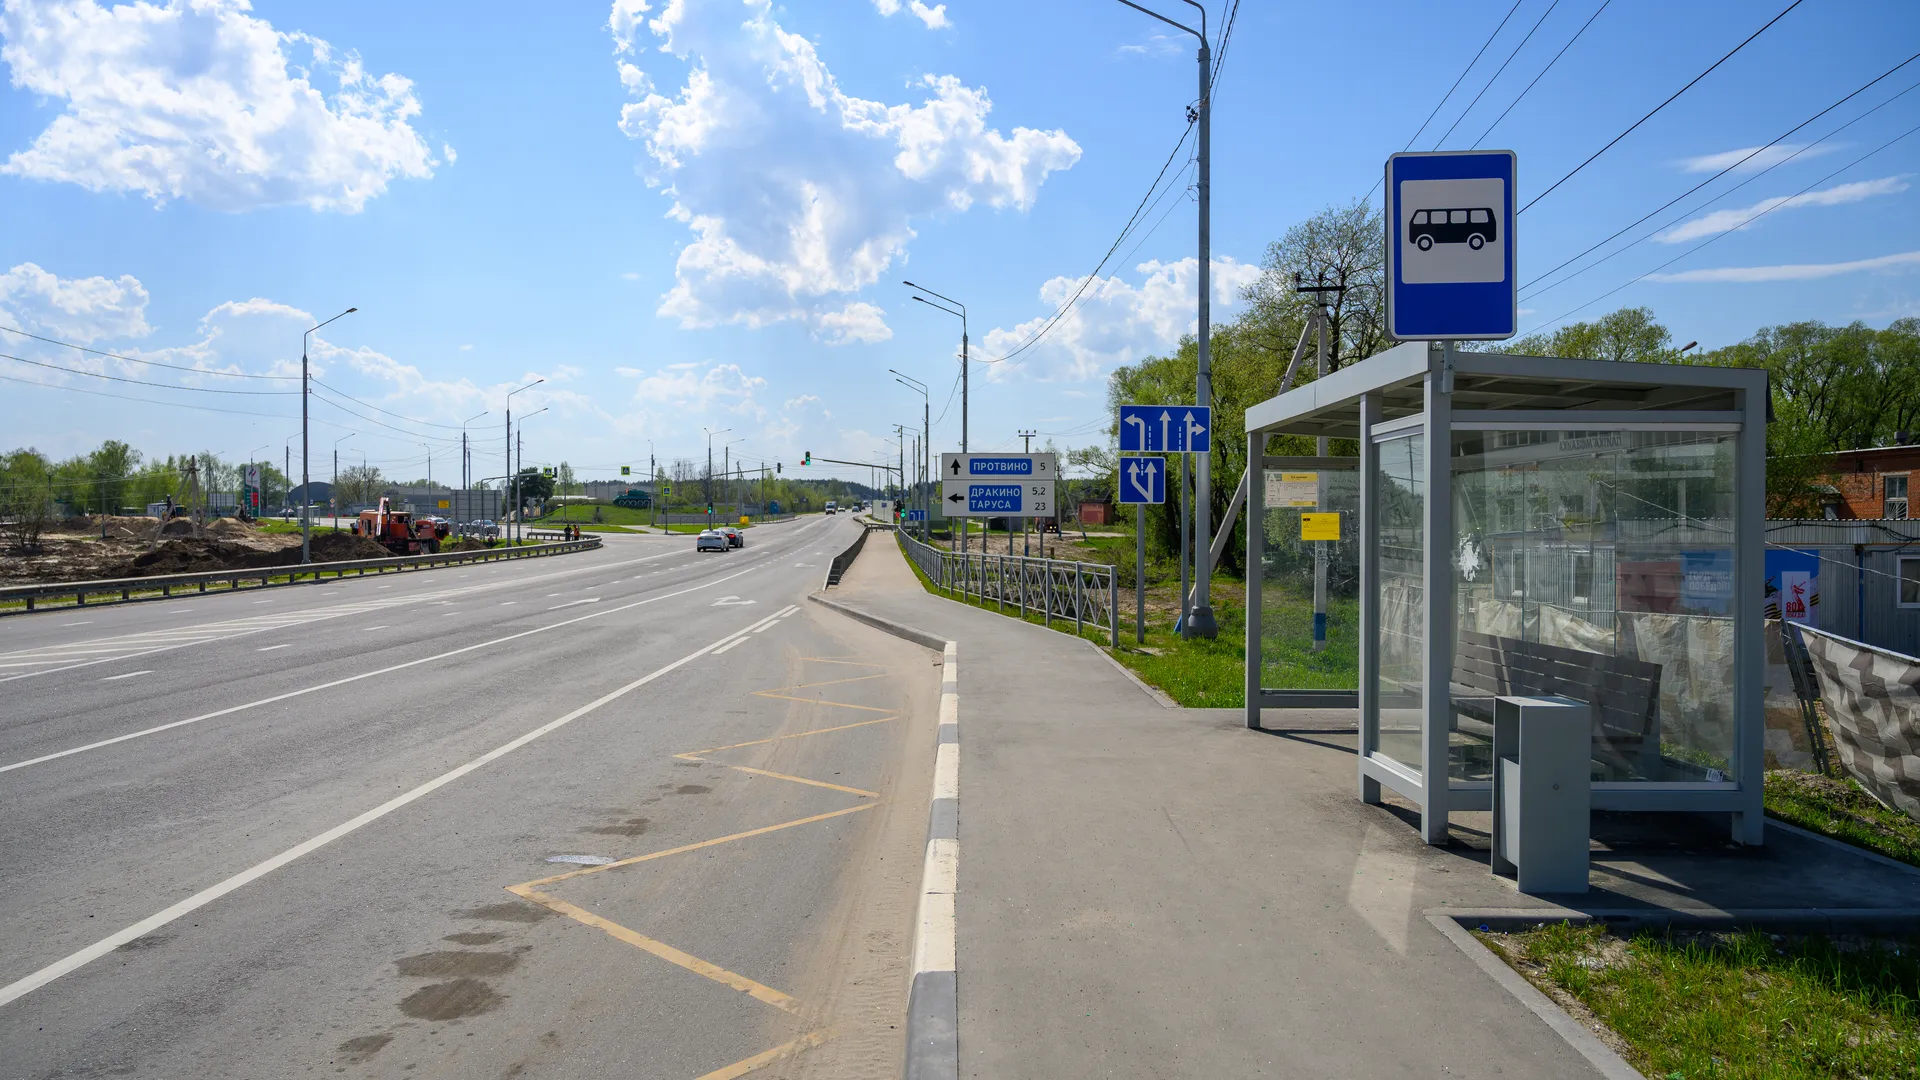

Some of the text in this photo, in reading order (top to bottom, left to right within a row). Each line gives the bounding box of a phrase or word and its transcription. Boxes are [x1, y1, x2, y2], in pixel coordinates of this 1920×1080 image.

[973, 462, 1046, 471] ПРОТВИНО 5
[970, 487, 1046, 498] ДРАКИНО 5,2
[970, 500, 1046, 511] ТАРУСА 23
[1786, 601, 1797, 612] 80
